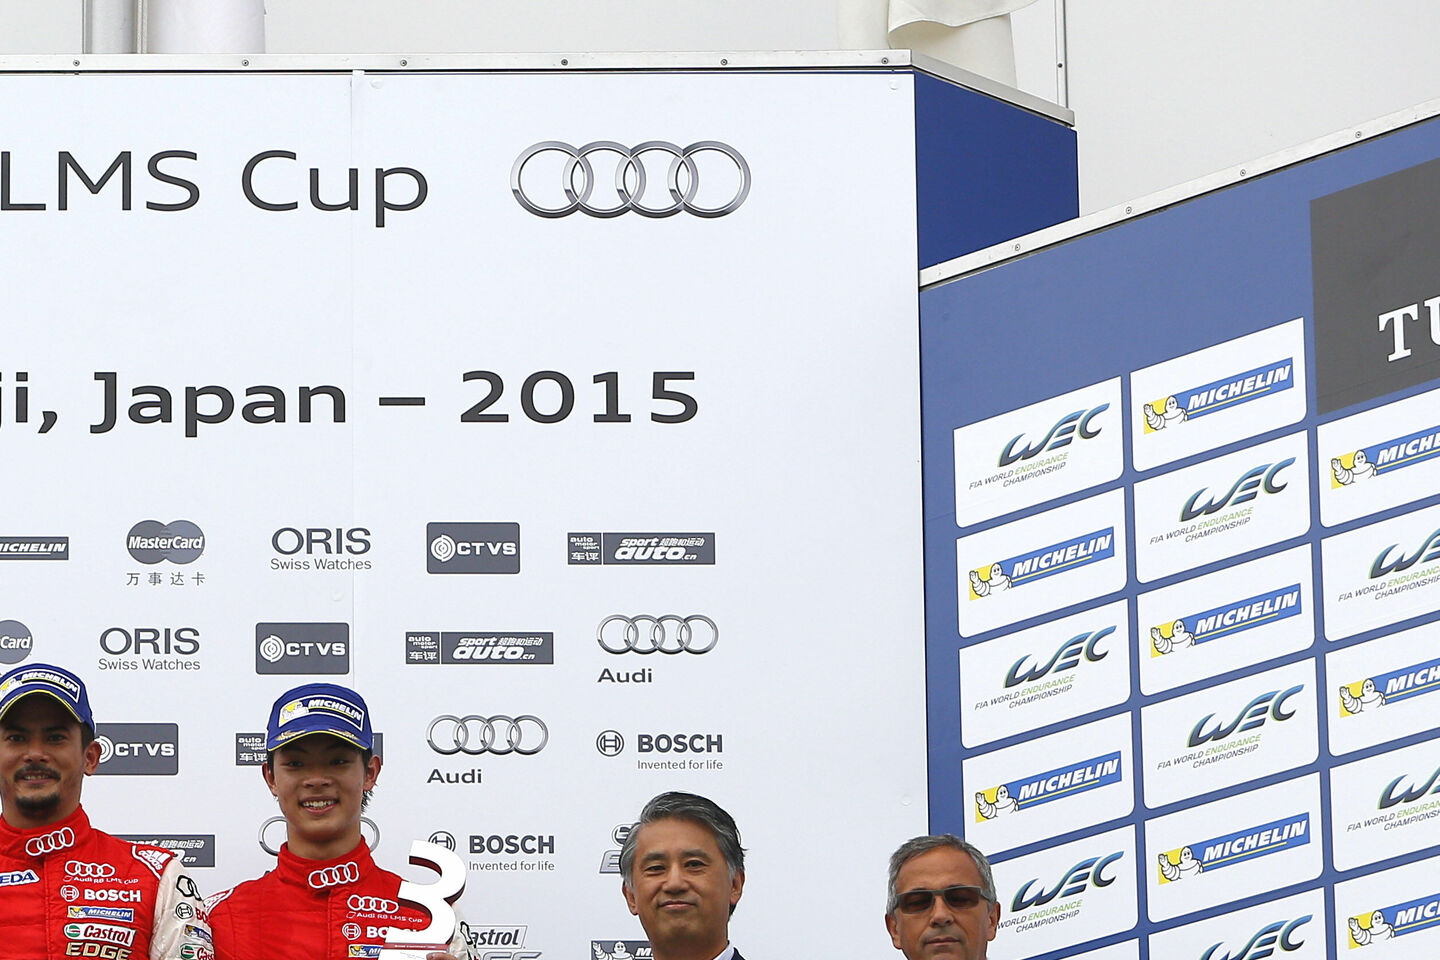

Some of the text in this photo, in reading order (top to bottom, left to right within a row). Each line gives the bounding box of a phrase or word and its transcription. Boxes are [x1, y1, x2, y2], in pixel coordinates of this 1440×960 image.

[1, 150, 201, 212] LMS
[242, 150, 428, 227] Cup
[1188, 365, 1291, 409] MICHELIN
[90, 371, 346, 437] Japan
[460, 371, 699, 425] 2015
[969, 452, 1068, 490] FIA WORLD ENDURANCE
[1002, 461, 1066, 488] CHAMPIONSHIP
[1150, 507, 1253, 544] FIA WORLD ENDURANCE
[1185, 517, 1250, 543] CHAMPIONSHIP
[128, 535, 203, 550] MasterCard
[271, 527, 371, 555] ORIS
[620, 537, 659, 547] sport
[270, 558, 372, 570] Swiss Watches
[1012, 534, 1111, 577] MICHELIN
[126, 572, 206, 586] 万事达卡
[1195, 591, 1298, 635] MICHELIN
[99, 628, 200, 654] ORIS
[458, 637, 497, 647] sport
[98, 658, 200, 670] Swiss Watches
[21, 671, 78, 693] MICHELIN
[598, 668, 652, 683] Audi
[308, 699, 362, 720] MICHELIN
[638, 733, 722, 753] BOSCH
[638, 759, 723, 769] Invented for life
[427, 768, 482, 783] Audi
[1018, 758, 1119, 800] MICHELIN
[469, 835, 554, 854] BOSCH
[1203, 820, 1307, 862] MICHELIN
[138, 850, 163, 870] adidas
[469, 861, 555, 871] Invented for life
[84, 889, 142, 902] BOSCH
[386, 840, 467, 944] 3
[87, 909, 131, 918] MICHELIN
[83, 925, 132, 944] Castrol
[471, 928, 520, 946] astrol
